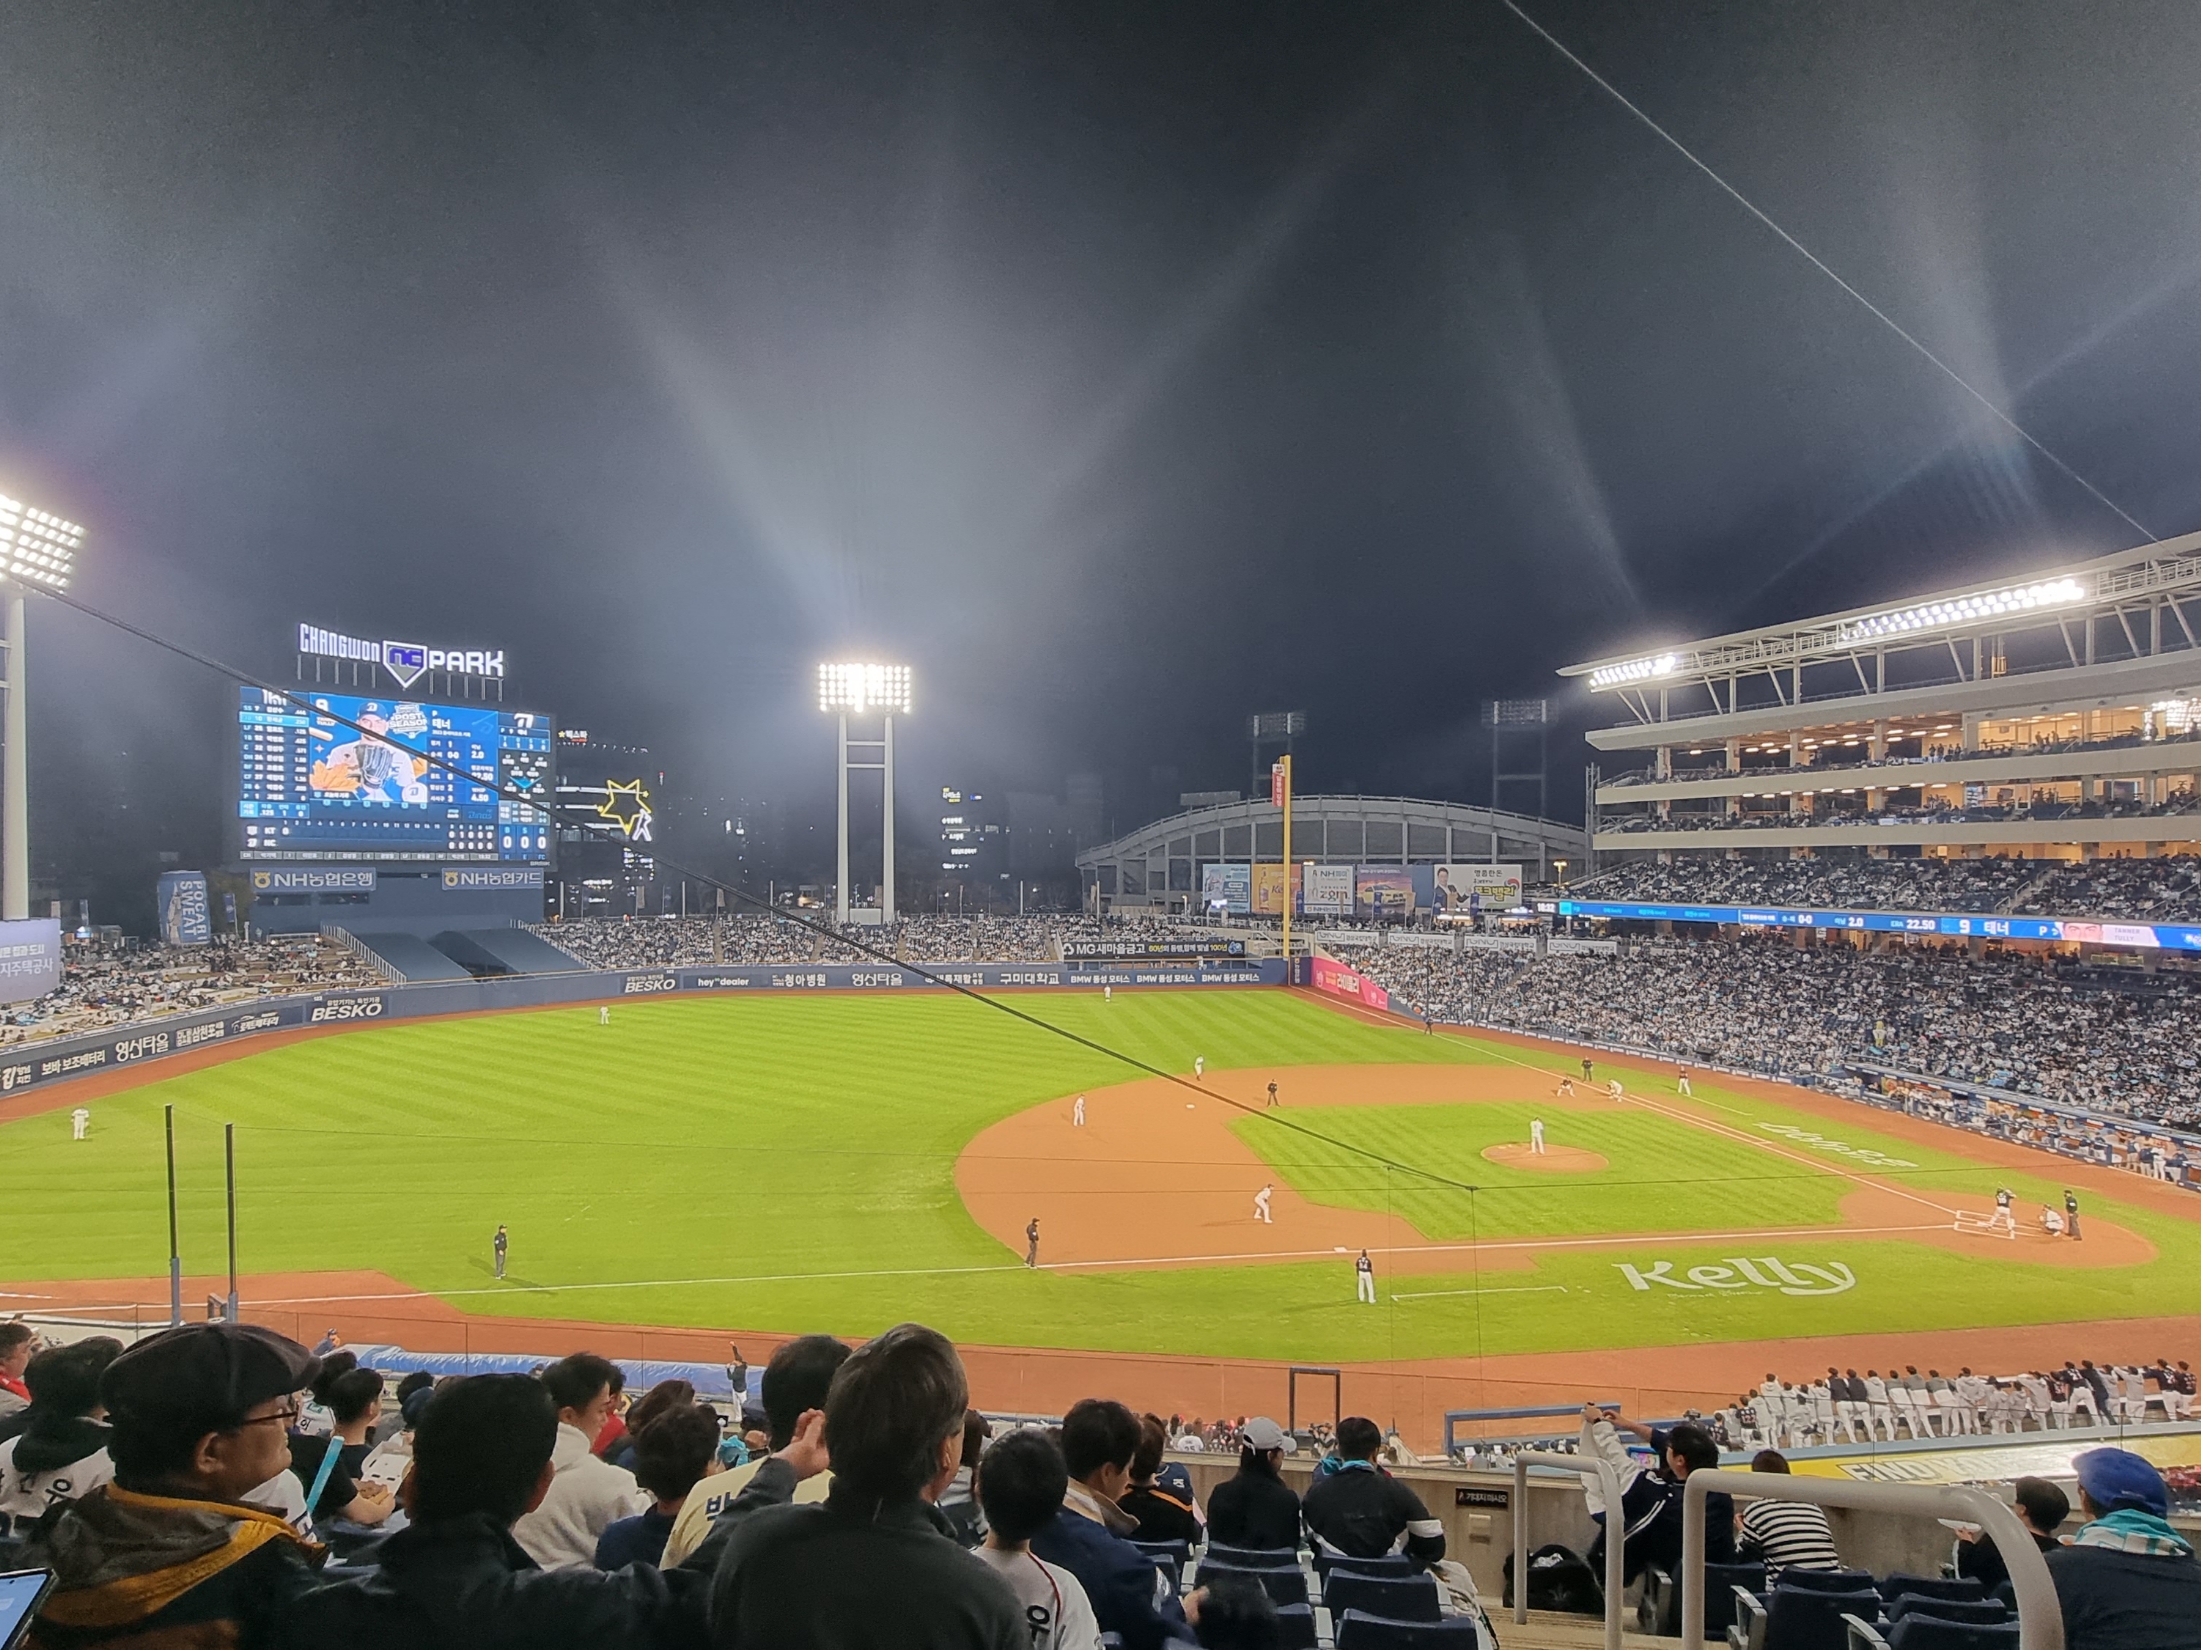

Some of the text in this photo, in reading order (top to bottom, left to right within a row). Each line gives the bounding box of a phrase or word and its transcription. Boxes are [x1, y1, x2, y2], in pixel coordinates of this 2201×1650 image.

[300, 622, 380, 662] CHANGWON
[429, 650, 503, 676] PARK
[431, 718, 451, 730] 태너
[471, 750, 485, 759] 2.0
[471, 793, 489, 803] 4.50
[503, 836, 546, 849] 0 0 0
[274, 872, 373, 887] NH농협은행
[461, 872, 542, 885] NH농협카드
[180, 881, 208, 940] POCARI SWEAT
[1798, 914, 1813, 924] 0-0
[1848, 917, 1864, 927] 2.0
[1906, 919, 1936, 930] 22.50
[1959, 919, 2009, 936] 9 태너
[2039, 926, 2048, 936] P
[1076, 943, 1146, 955] MG새마을금고
[1210, 943, 1228, 953] 100년
[0, 957, 54, 978] 지주택공사
[698, 977, 749, 989] hey dealer
[1000, 973, 1060, 985] 구미대학교
[1070, 975, 1092, 984] BMW
[1108, 974, 1131, 984] 모터스
[1136, 974, 1158, 983] BMW
[1174, 974, 1196, 983] 모터스
[1202, 974, 1222, 983] BMW
[1239, 973, 1260, 983] 모터스
[624, 978, 676, 994] BESKO
[311, 1004, 382, 1022] BESKO
[192, 1024, 216, 1043] 삼천포
[1611, 1257, 1856, 1296] Kelly
[1847, 1461, 1938, 1483] FIND
